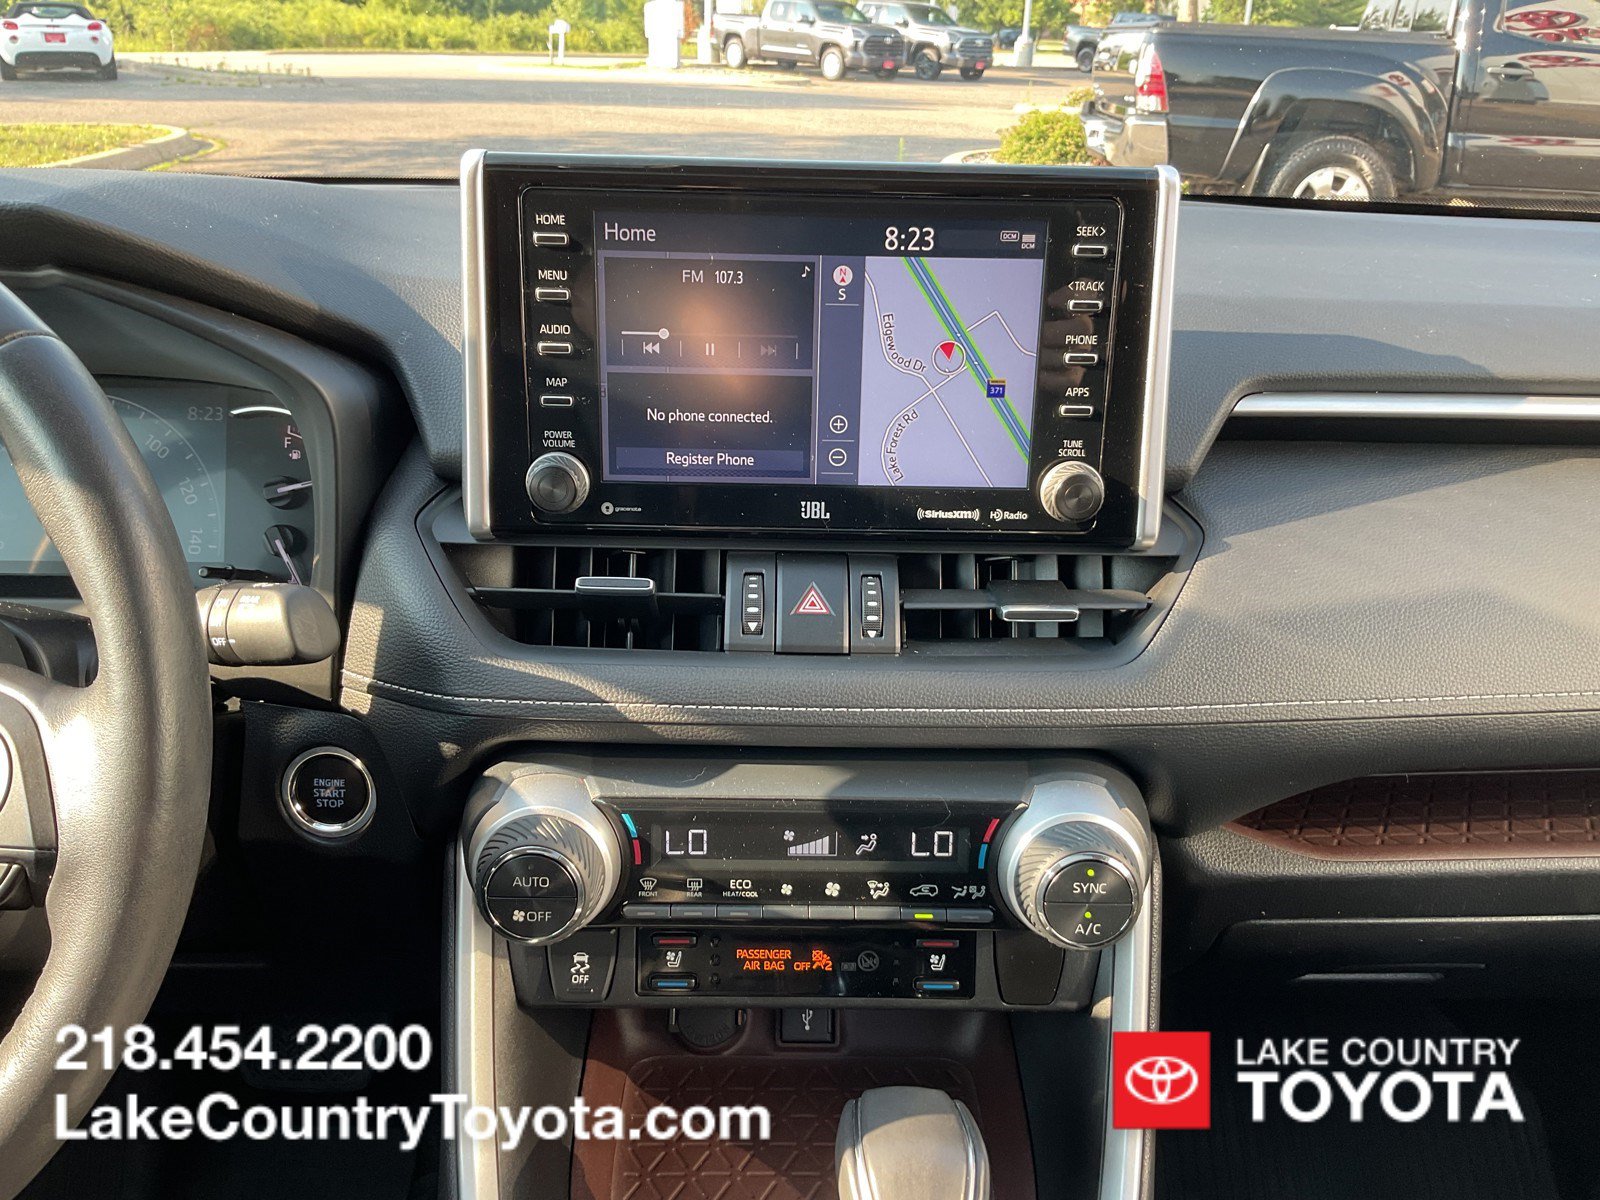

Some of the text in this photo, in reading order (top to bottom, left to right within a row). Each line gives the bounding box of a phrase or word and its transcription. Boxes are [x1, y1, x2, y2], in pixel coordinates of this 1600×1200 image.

[535, 214, 566, 226] HOME
[604, 222, 657, 242] Home
[885, 226, 935, 251] 8:23
[538, 270, 568, 281] MENU
[682, 270, 744, 284] FM 107.3
[838, 288, 847, 301] S
[539, 324, 571, 335] AUDIO
[883, 313, 926, 373] Edgewood Dr
[1065, 334, 1098, 346] PHONE
[546, 377, 568, 388] MAP
[1065, 387, 1090, 398] APPS
[187, 407, 223, 421] 8:23
[647, 408, 773, 425] No phone connected.
[544, 430, 573, 439] POWER
[144, 434, 170, 460] 100
[542, 440, 576, 448] VOLUME
[886, 409, 919, 482] Lake Forest Rd
[1063, 439, 1083, 448] TUNE
[1058, 448, 1085, 457] SCROLL
[666, 452, 754, 466] Register Phone
[178, 477, 198, 505] 120
[801, 501, 830, 519] JBL
[1004, 511, 1028, 520] Radio
[188, 529, 203, 555] 140
[211, 637, 226, 646] OFF
[313, 778, 346, 788] ENGINE
[313, 789, 346, 798] START
[316, 799, 344, 808] STOP
[665, 829, 708, 855] LO
[911, 830, 954, 857] LO
[512, 876, 550, 888] AUTO
[730, 879, 751, 889] ECO
[1073, 882, 1107, 894] SYNC
[526, 911, 552, 922] OFF
[1075, 923, 1101, 935] A/C
[736, 949, 791, 959] PASSENGER
[743, 961, 810, 971] AIR BAG OFF
[571, 974, 590, 984] OFF
